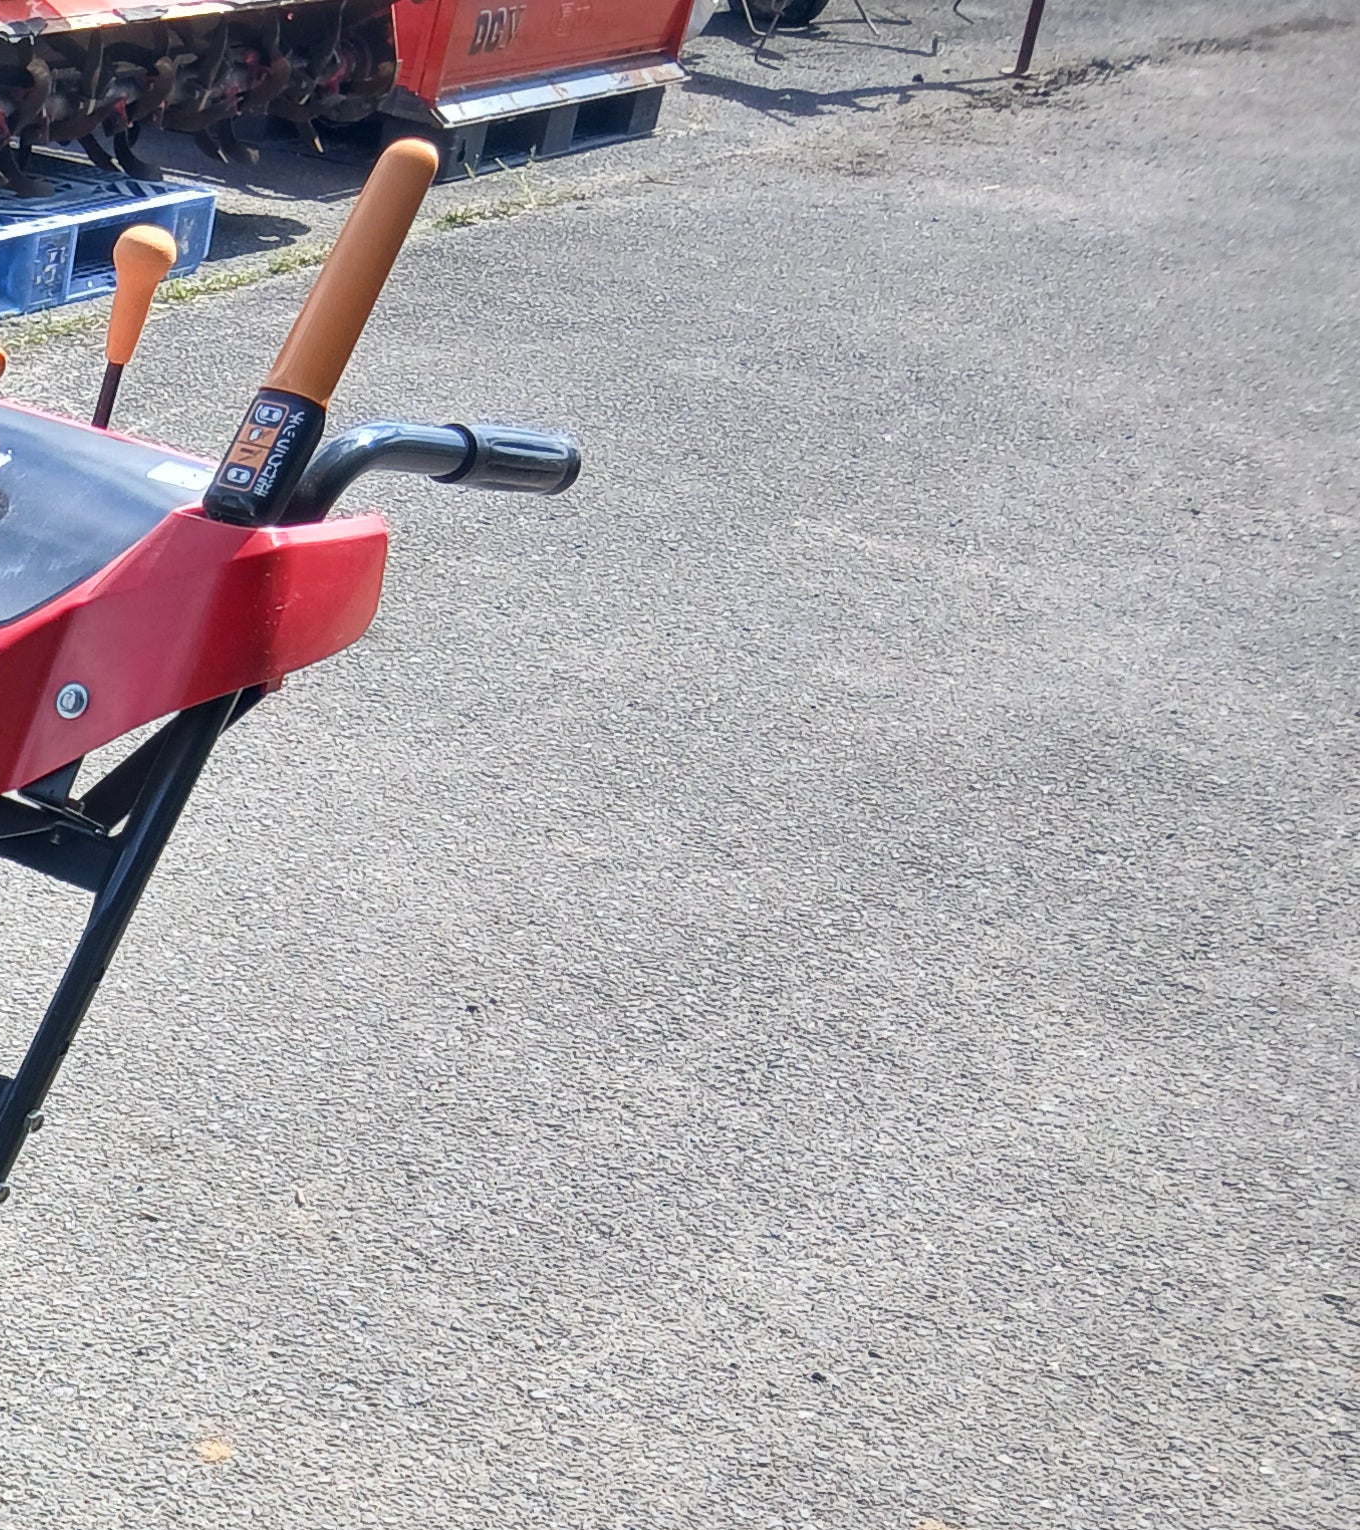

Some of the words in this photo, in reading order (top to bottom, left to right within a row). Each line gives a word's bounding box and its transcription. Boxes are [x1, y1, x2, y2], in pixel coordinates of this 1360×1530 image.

[253, 411, 305, 498] 走行クラッチ
